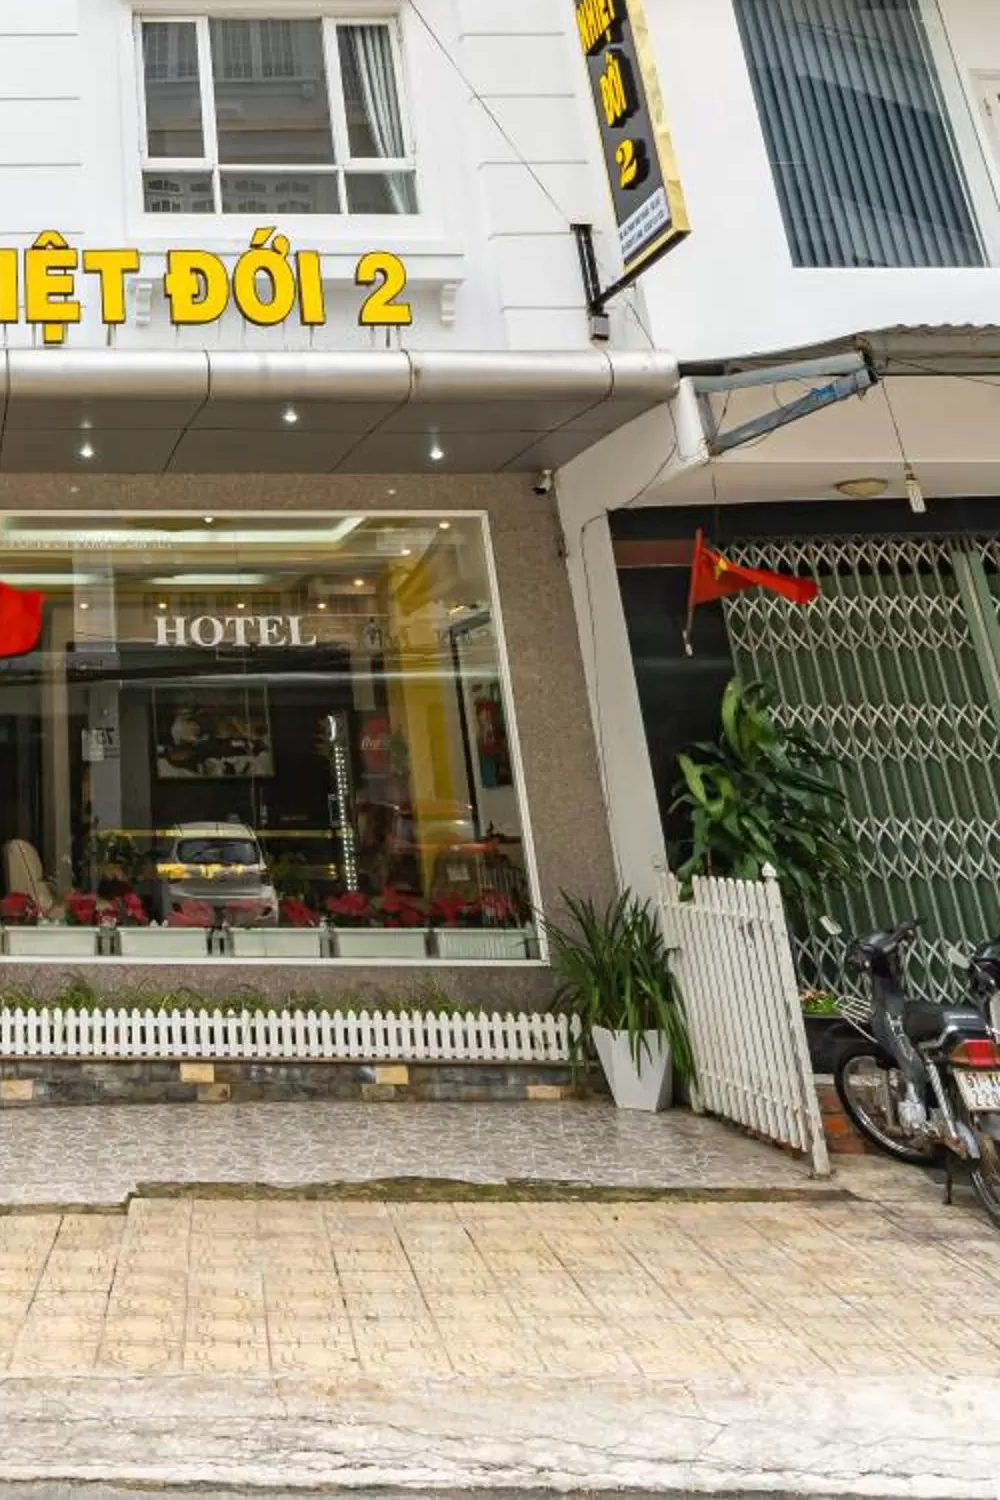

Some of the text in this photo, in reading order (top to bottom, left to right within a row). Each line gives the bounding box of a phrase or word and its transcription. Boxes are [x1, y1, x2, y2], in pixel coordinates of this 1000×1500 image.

[615, 139, 637, 189] 2
[164, 226, 326, 326] ĐỚI
[355, 250, 413, 326] 2
[153, 615, 318, 648] HOTEL
